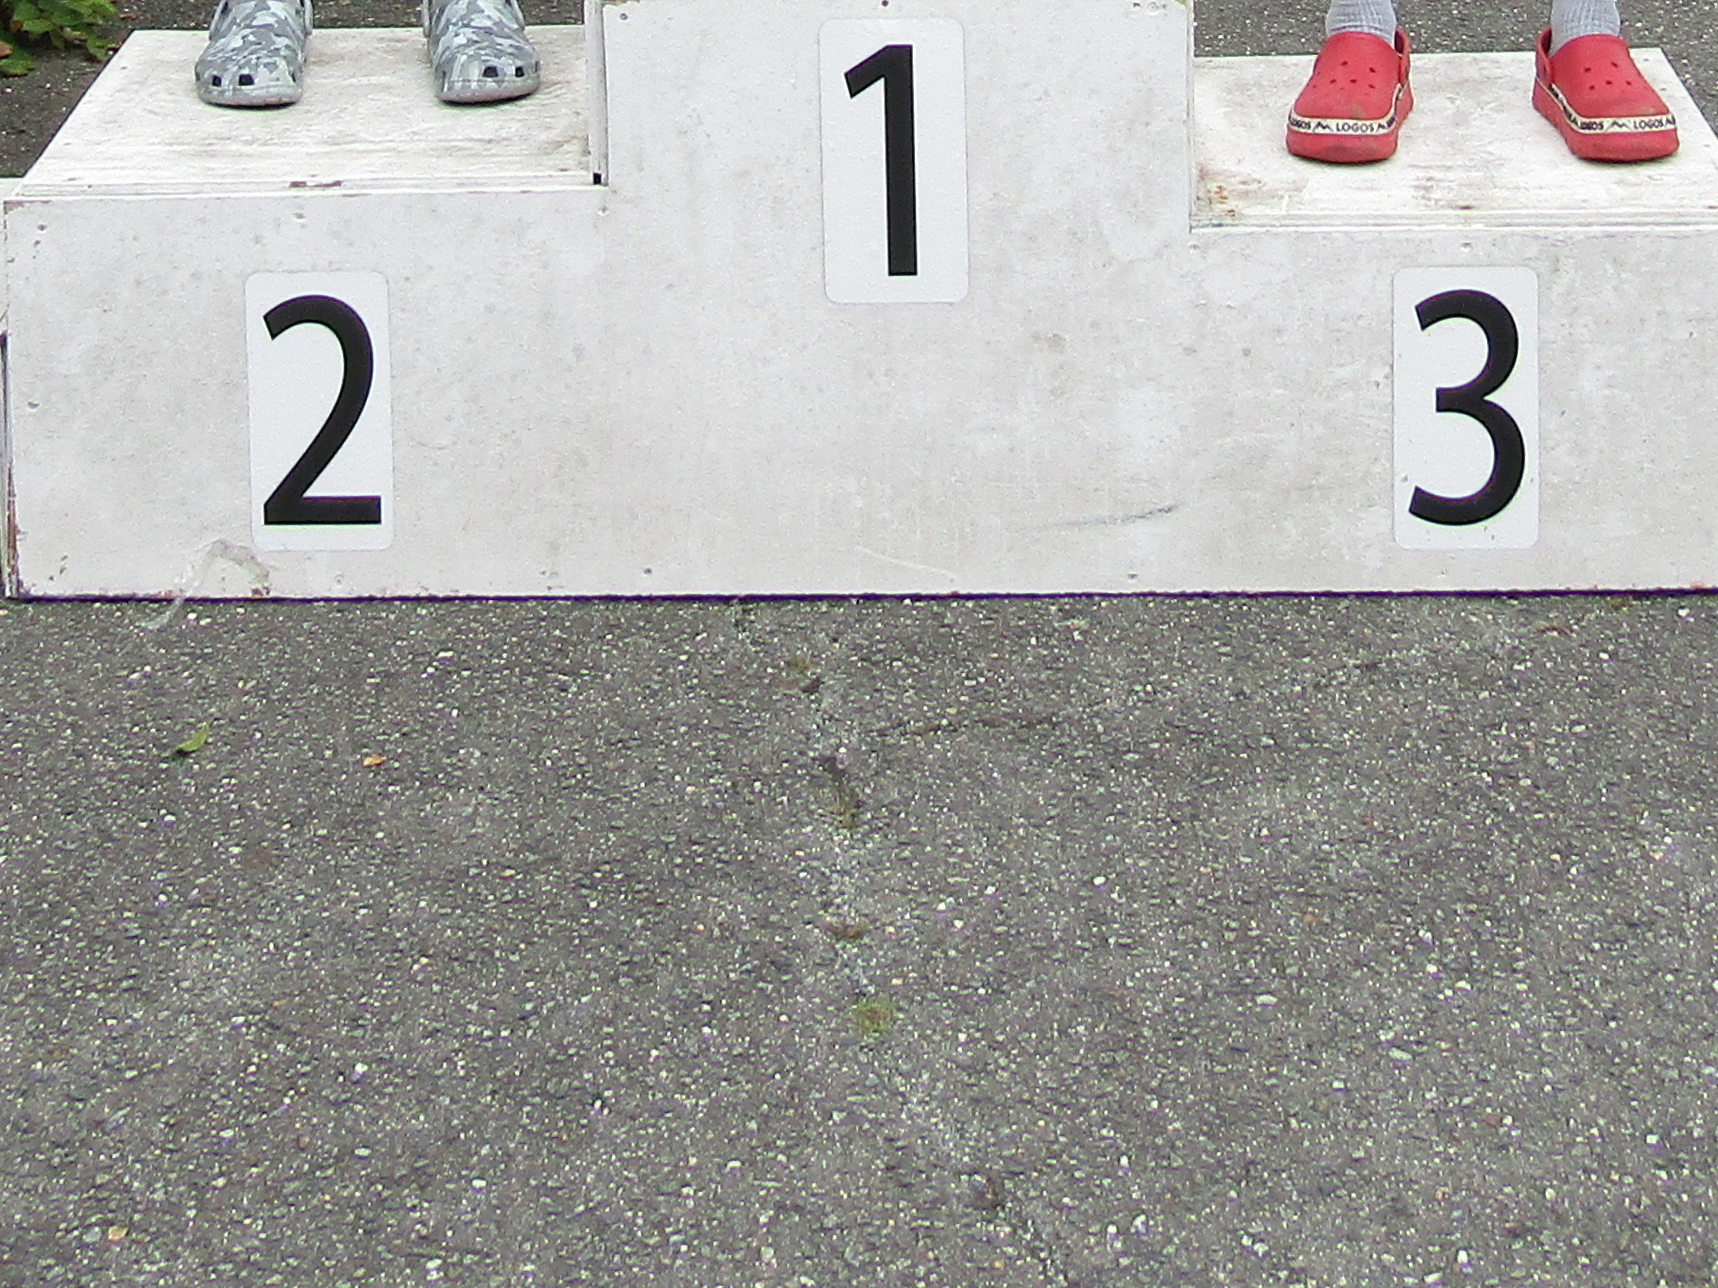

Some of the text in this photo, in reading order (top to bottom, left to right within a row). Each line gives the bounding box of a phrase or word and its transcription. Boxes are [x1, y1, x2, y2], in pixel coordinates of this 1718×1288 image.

[844, 44, 919, 277] 1
[1336, 122, 1376, 133] LOGOS
[1634, 118, 1664, 130] LOGOS
[263, 294, 382, 526] 2
[1409, 289, 1526, 527] 3
